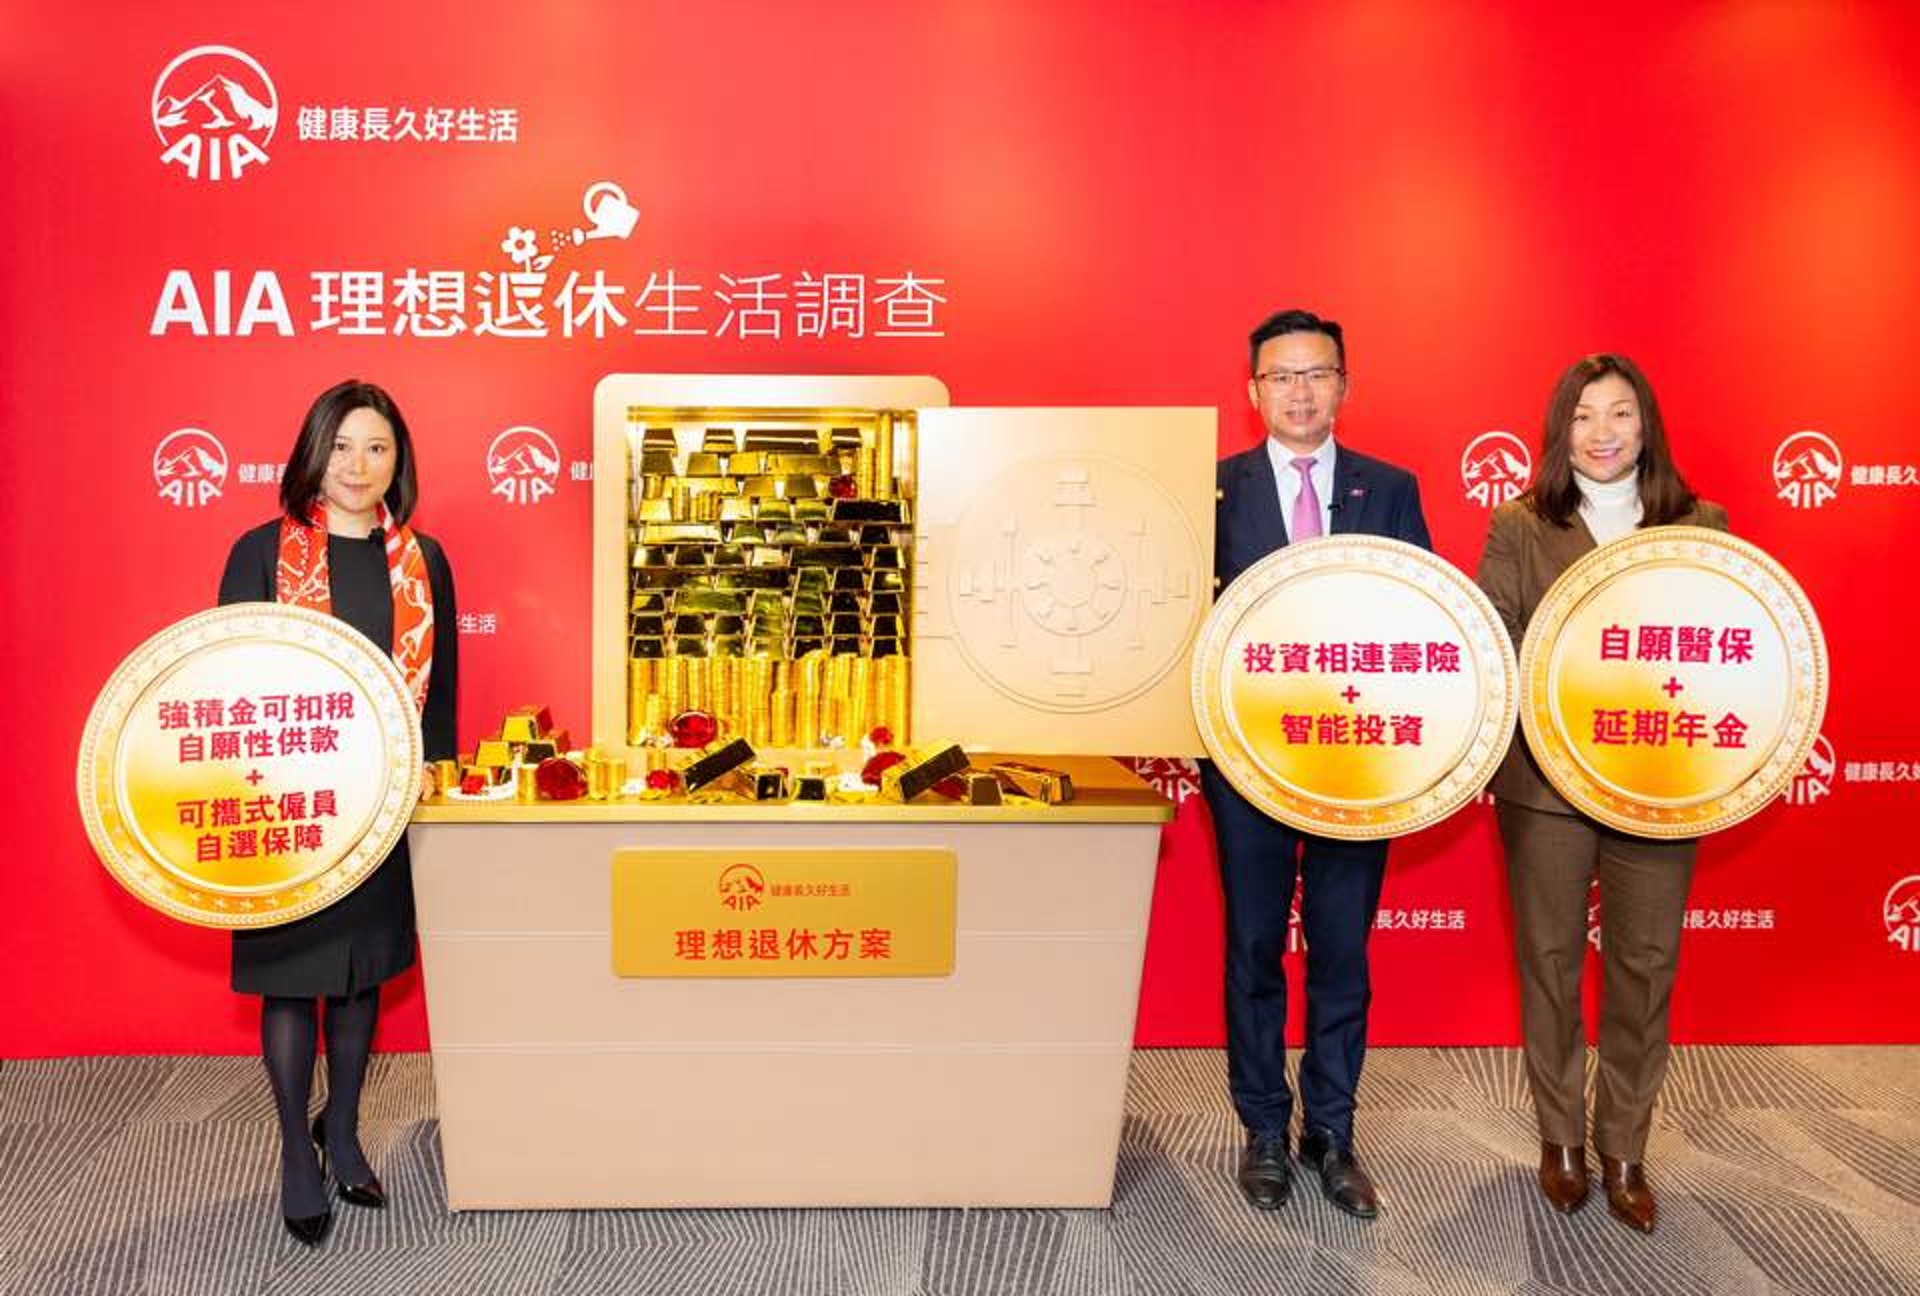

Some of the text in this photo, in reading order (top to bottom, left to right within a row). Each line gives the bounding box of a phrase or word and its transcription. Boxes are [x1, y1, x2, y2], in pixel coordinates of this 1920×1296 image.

[297, 106, 518, 144] 健康長久好生活
[160, 132, 270, 181] AIA
[149, 269, 948, 340] AIA 理想退休生活調查
[571, 461, 594, 481] 健
[159, 479, 222, 508] AIA
[491, 476, 555, 505] AIA
[1465, 480, 1523, 509] AIA
[1777, 479, 1837, 509] AIA
[456, 612, 497, 635] 生活
[1243, 641, 1462, 673] 投資相連壽險
[1599, 624, 1754, 665] 自願醫保
[178, 724, 339, 763] 自願性供款
[1280, 713, 1424, 746] 智能投資
[1591, 708, 1749, 750] 延期年金
[176, 789, 338, 828] 可攜式僱員
[196, 823, 324, 863] 自選保障
[722, 895, 761, 912] AIA
[1371, 909, 1466, 930] 長久好生活
[674, 927, 893, 961] 理想退休方案
